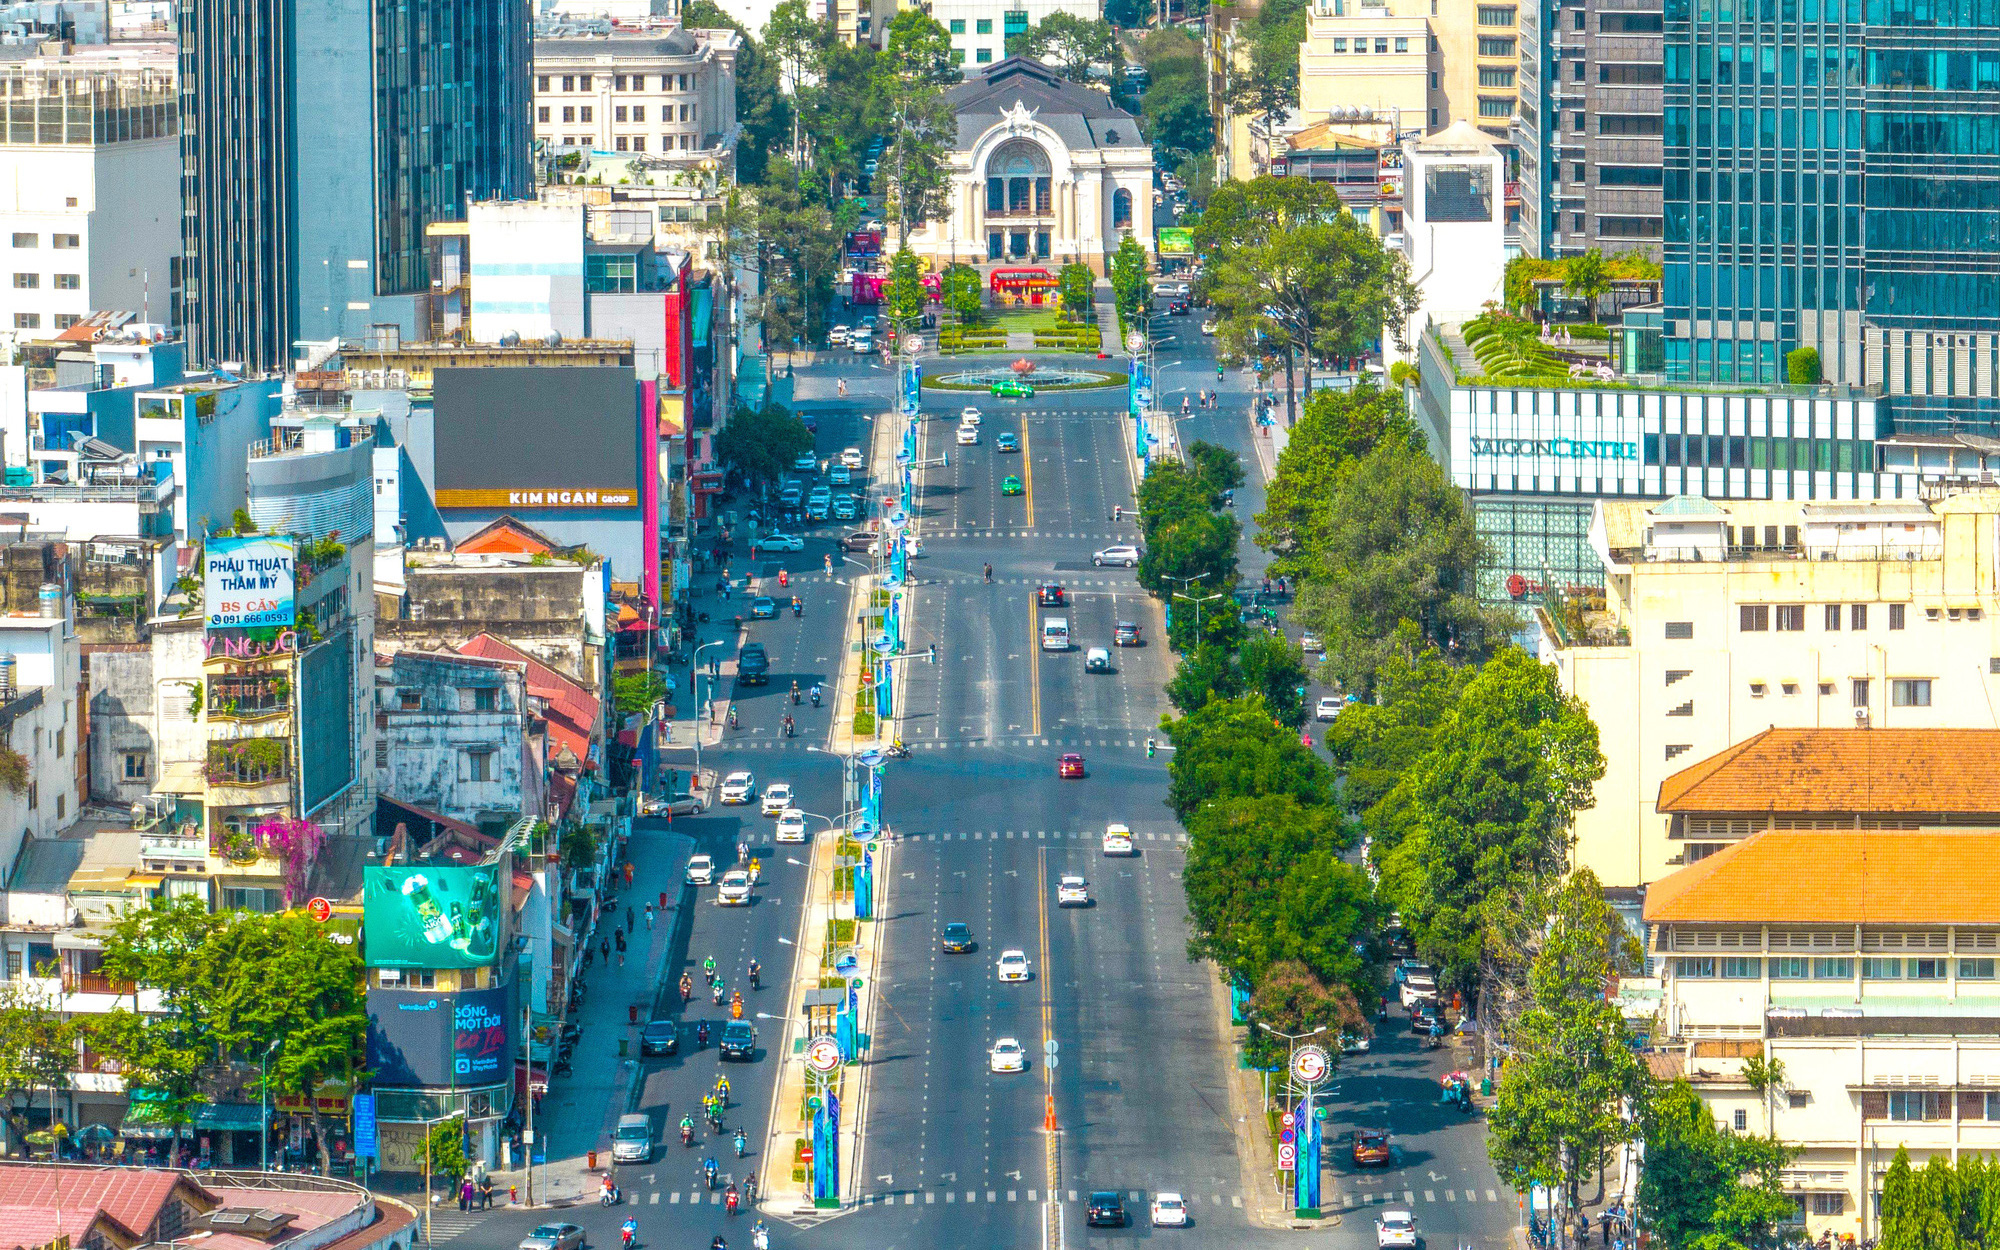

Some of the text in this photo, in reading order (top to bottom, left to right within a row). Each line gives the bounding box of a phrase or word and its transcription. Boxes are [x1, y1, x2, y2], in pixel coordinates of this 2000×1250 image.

[509, 491, 630, 504] KIM NGAN GROUP
[221, 598, 279, 612] BS CĂN
[223, 613, 288, 625] 091 666 0593
[455, 1004, 487, 1018] SỐNG
[455, 1016, 482, 1031] MỘT
